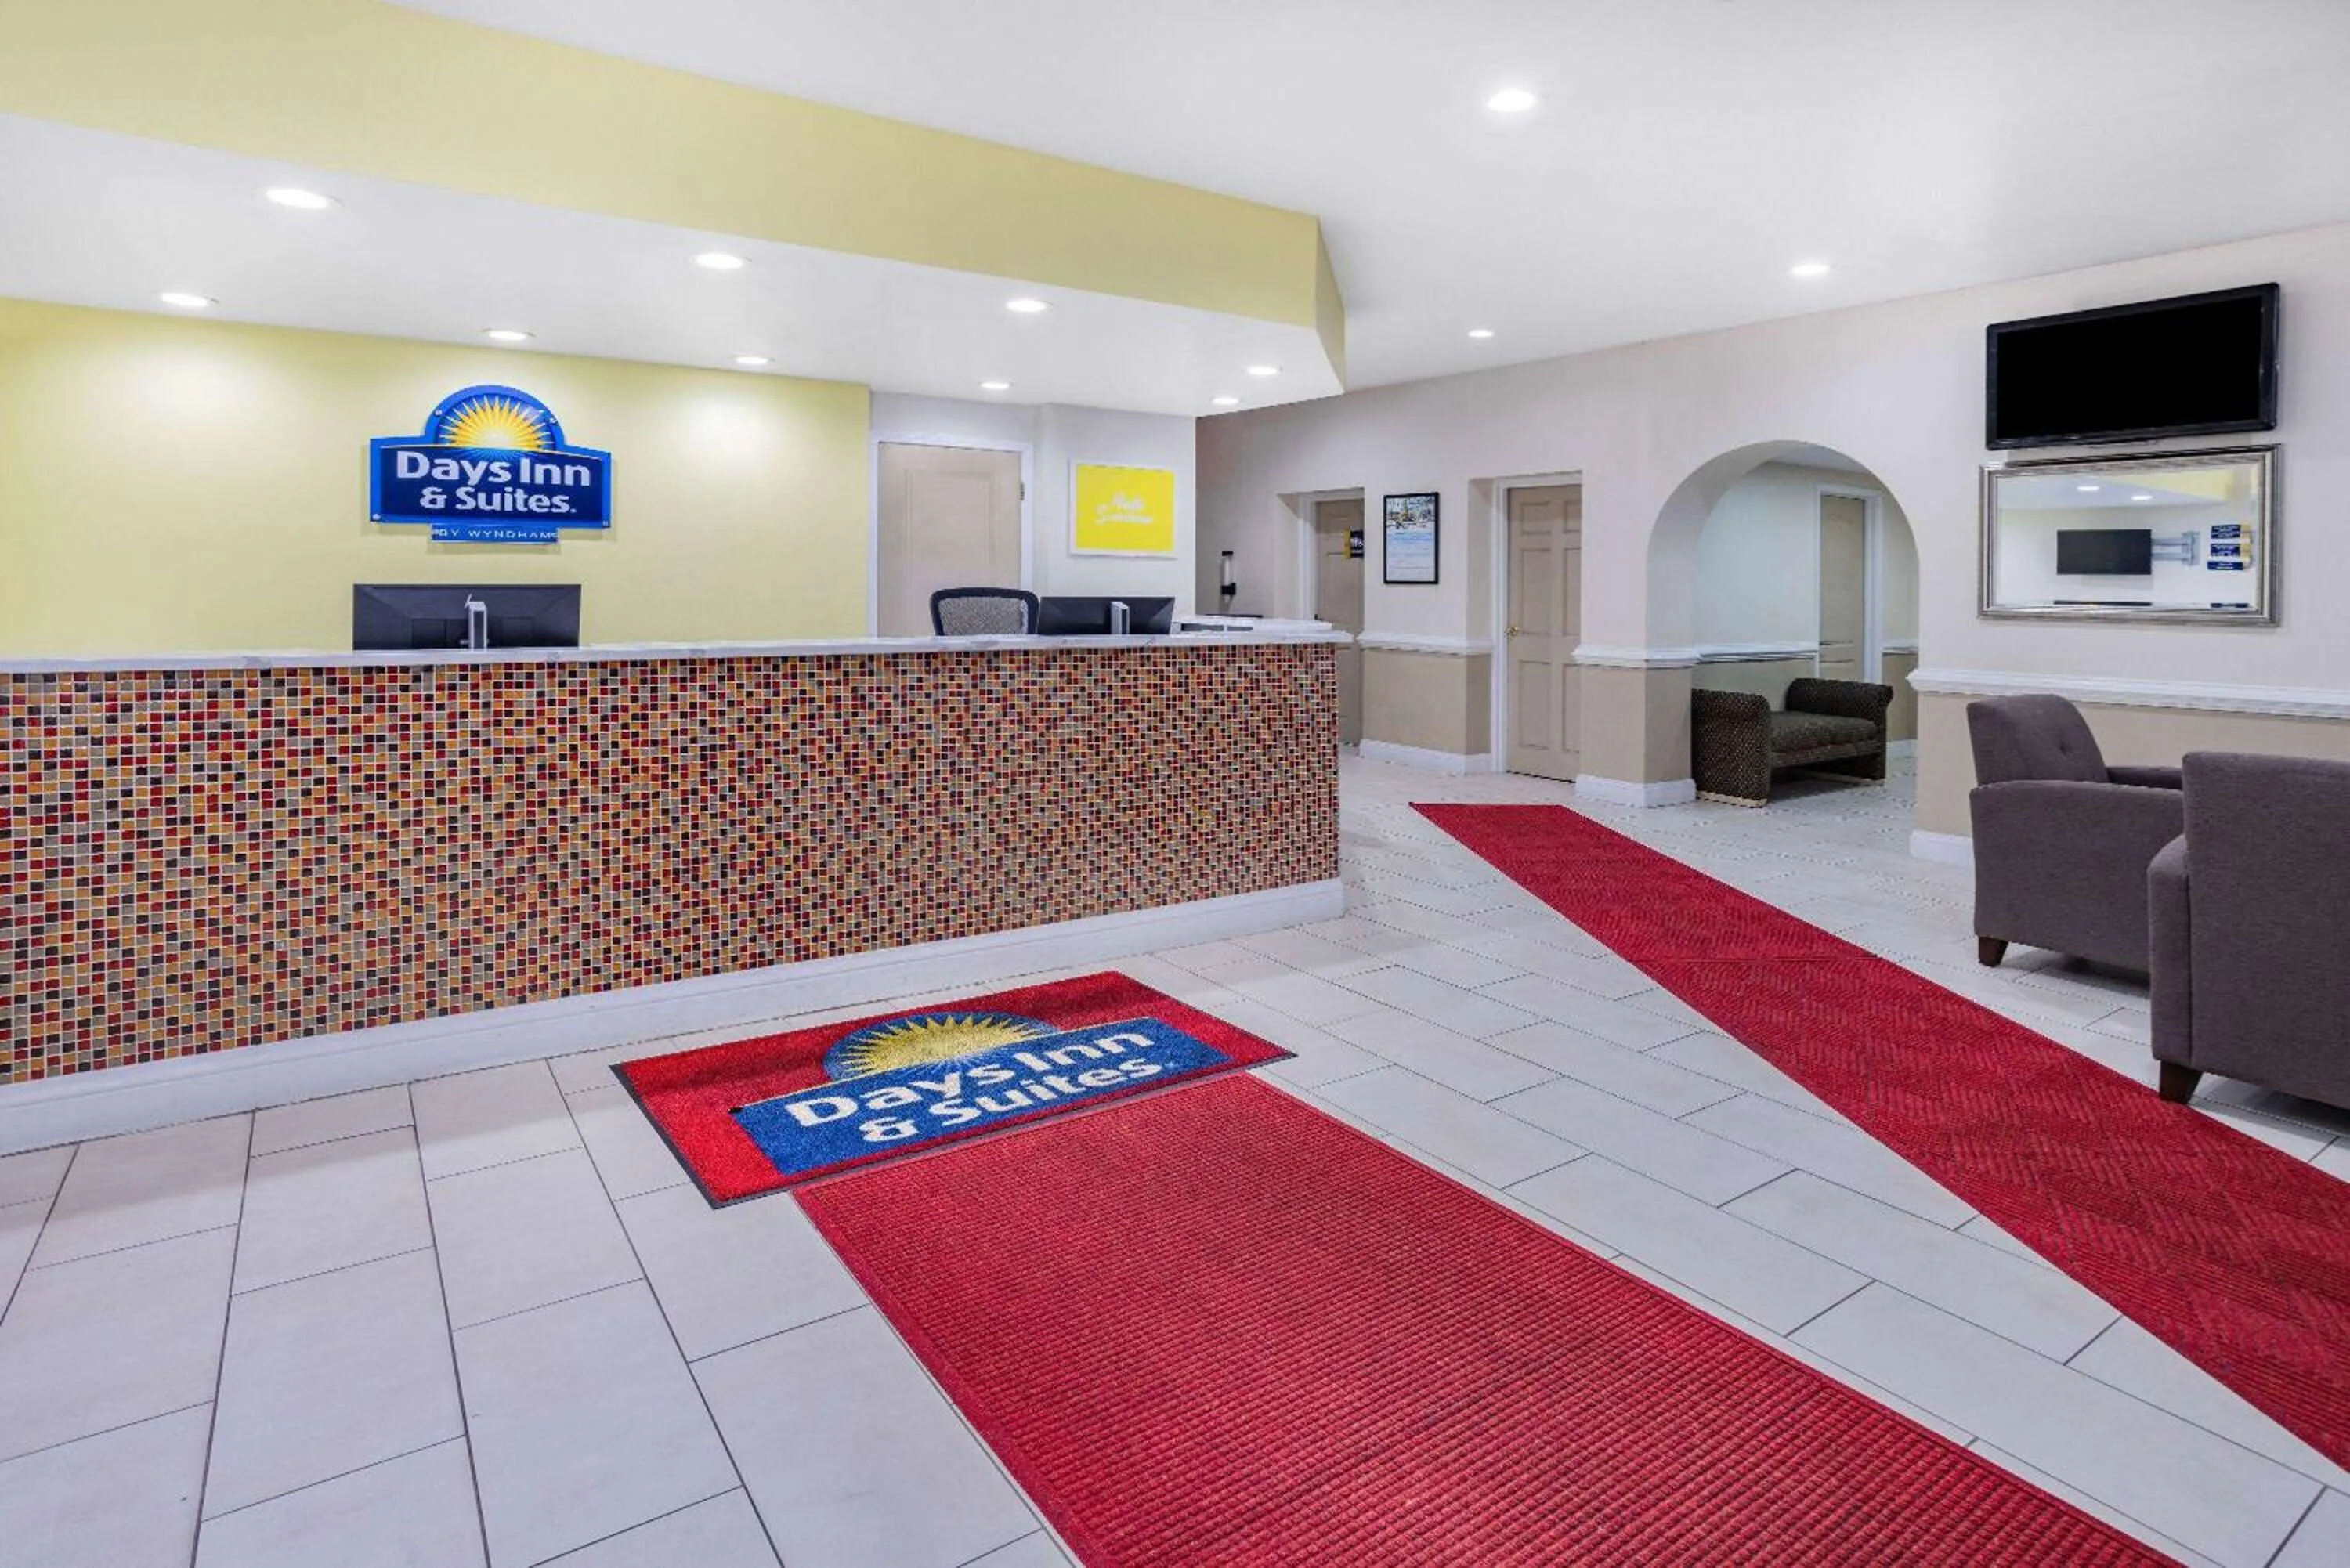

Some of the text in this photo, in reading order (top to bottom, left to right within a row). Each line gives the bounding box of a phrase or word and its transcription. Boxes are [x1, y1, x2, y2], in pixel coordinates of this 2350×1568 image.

[396, 451, 590, 486] Days Inn
[420, 487, 447, 509] &
[438, 529, 551, 539] BY WYNDHAM
[786, 1032, 1155, 1128] Days Inn
[859, 1057, 1162, 1142] & Suites
